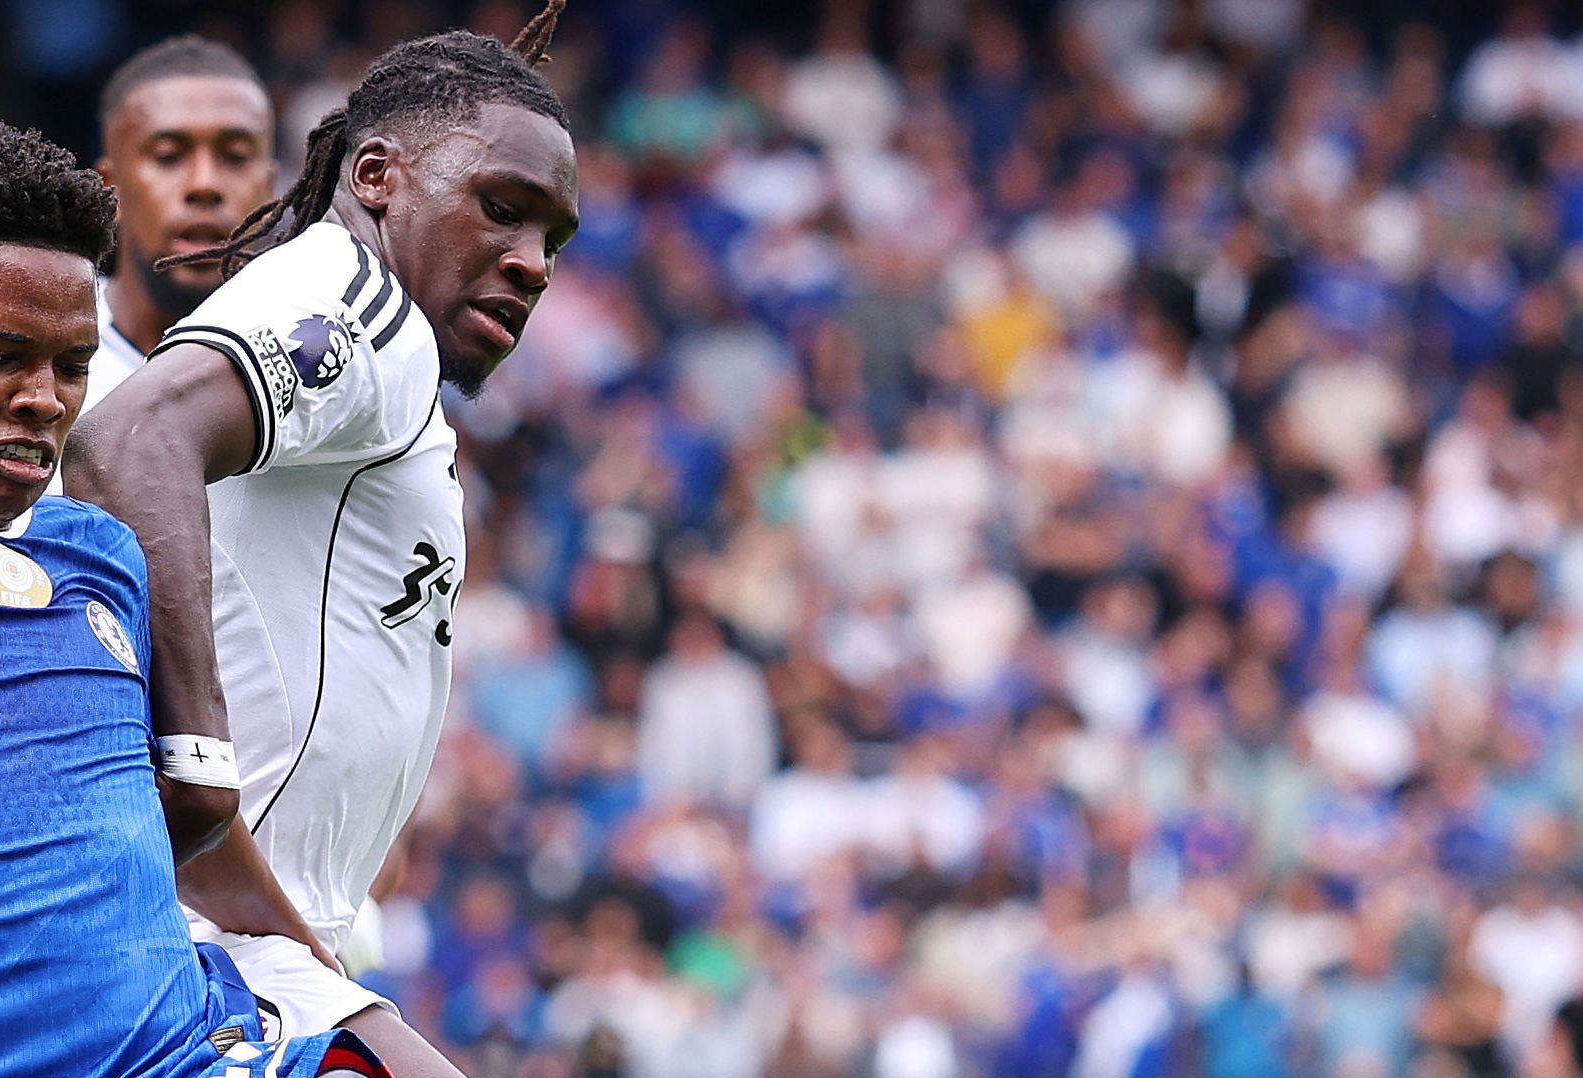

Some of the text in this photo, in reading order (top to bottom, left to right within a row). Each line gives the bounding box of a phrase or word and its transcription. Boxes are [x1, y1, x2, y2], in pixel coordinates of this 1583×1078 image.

[259, 327, 295, 408] No room
[1, 591, 32, 606] FIFA
